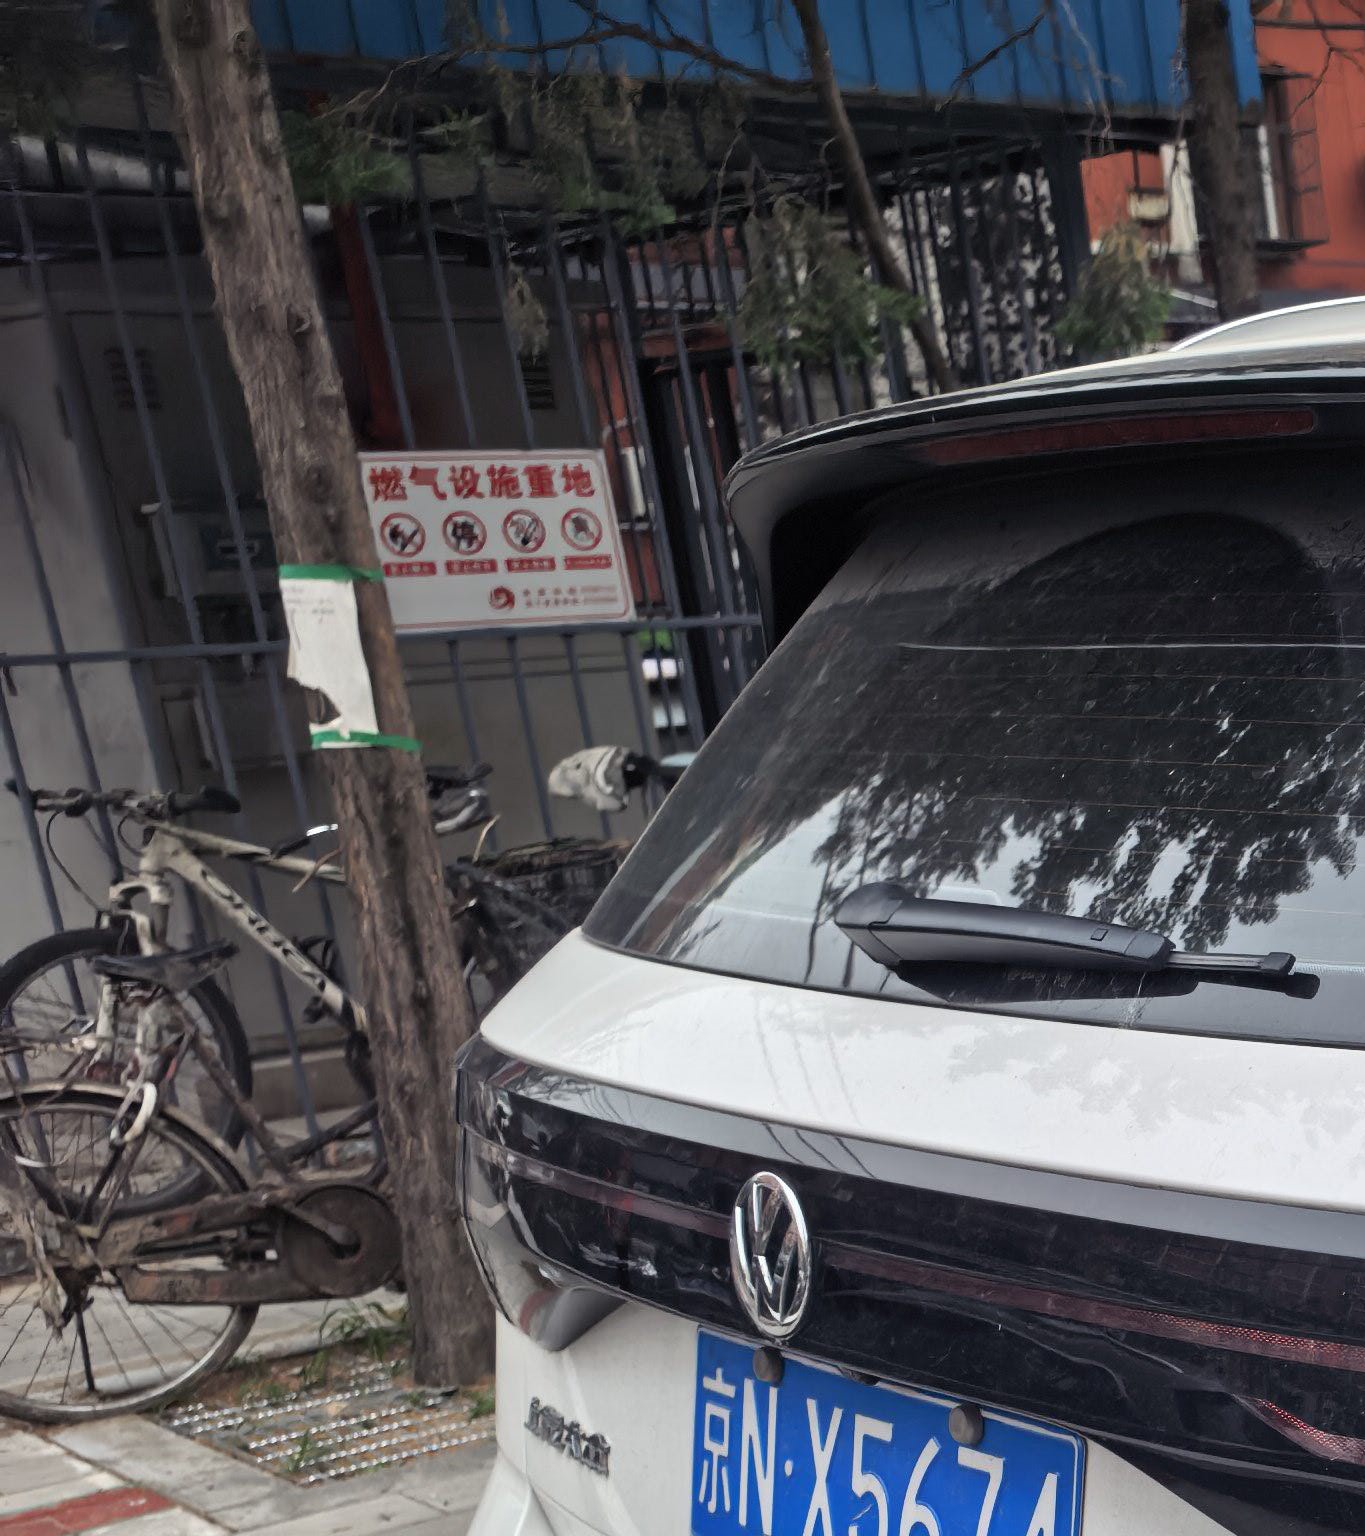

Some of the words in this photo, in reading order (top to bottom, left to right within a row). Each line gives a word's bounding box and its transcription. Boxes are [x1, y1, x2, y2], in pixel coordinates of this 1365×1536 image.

[368, 464, 595, 500] 燃气设施重地
